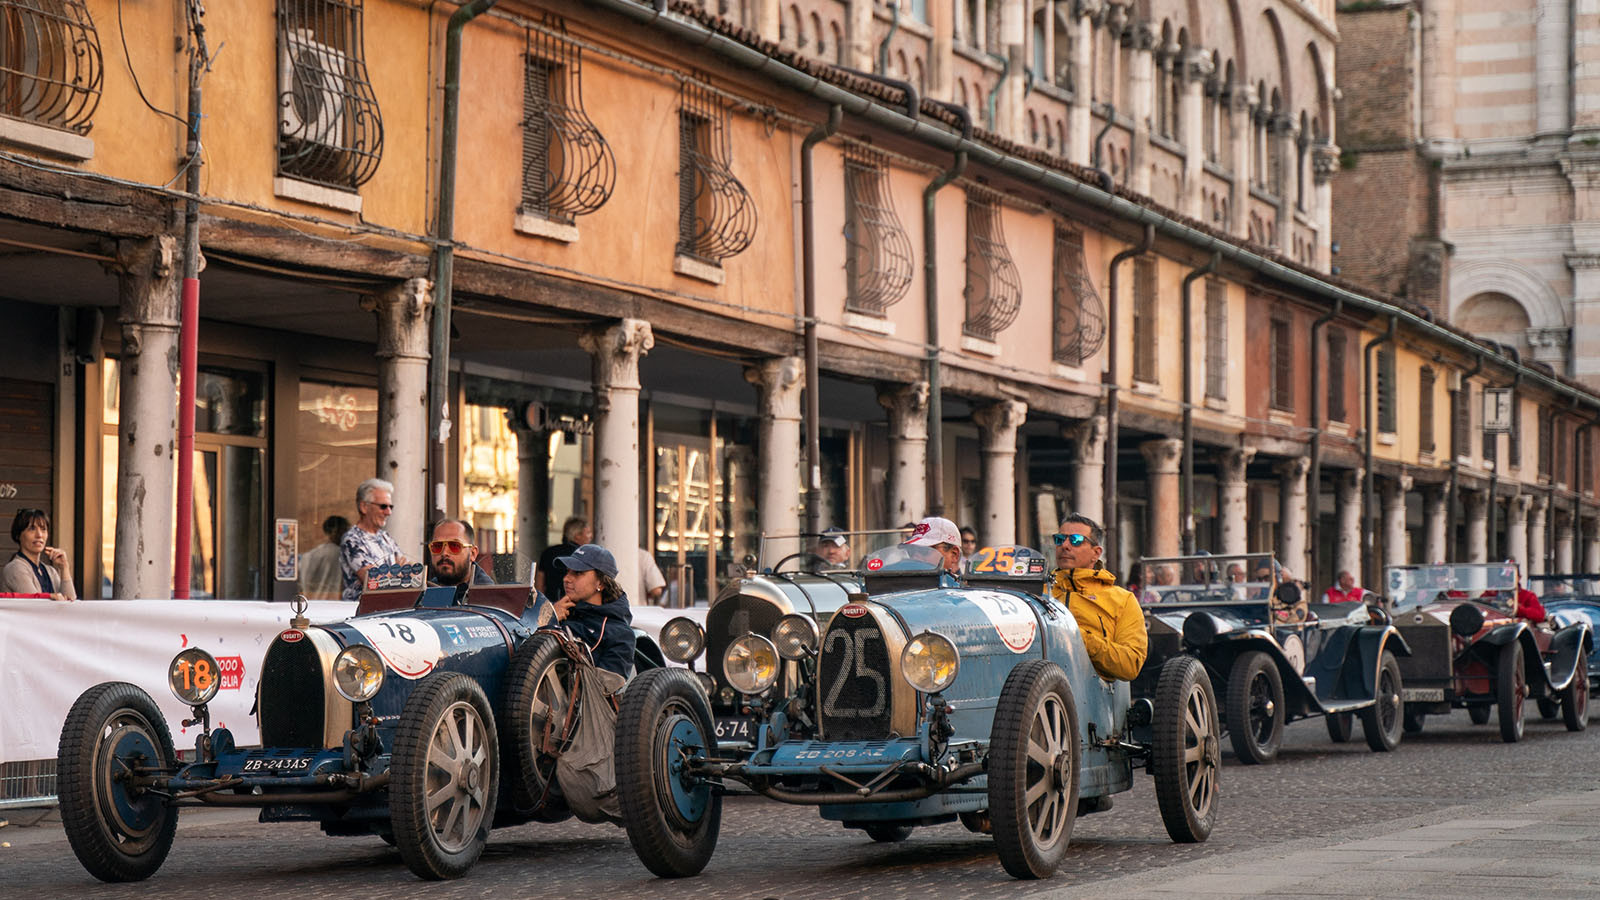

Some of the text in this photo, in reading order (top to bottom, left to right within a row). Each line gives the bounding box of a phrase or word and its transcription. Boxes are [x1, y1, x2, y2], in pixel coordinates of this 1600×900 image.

[975, 546, 1016, 572] 25
[379, 621, 417, 645] 18
[178, 659, 212, 690] 18
[220, 675, 239, 687] GLIA
[823, 627, 887, 718] 25
